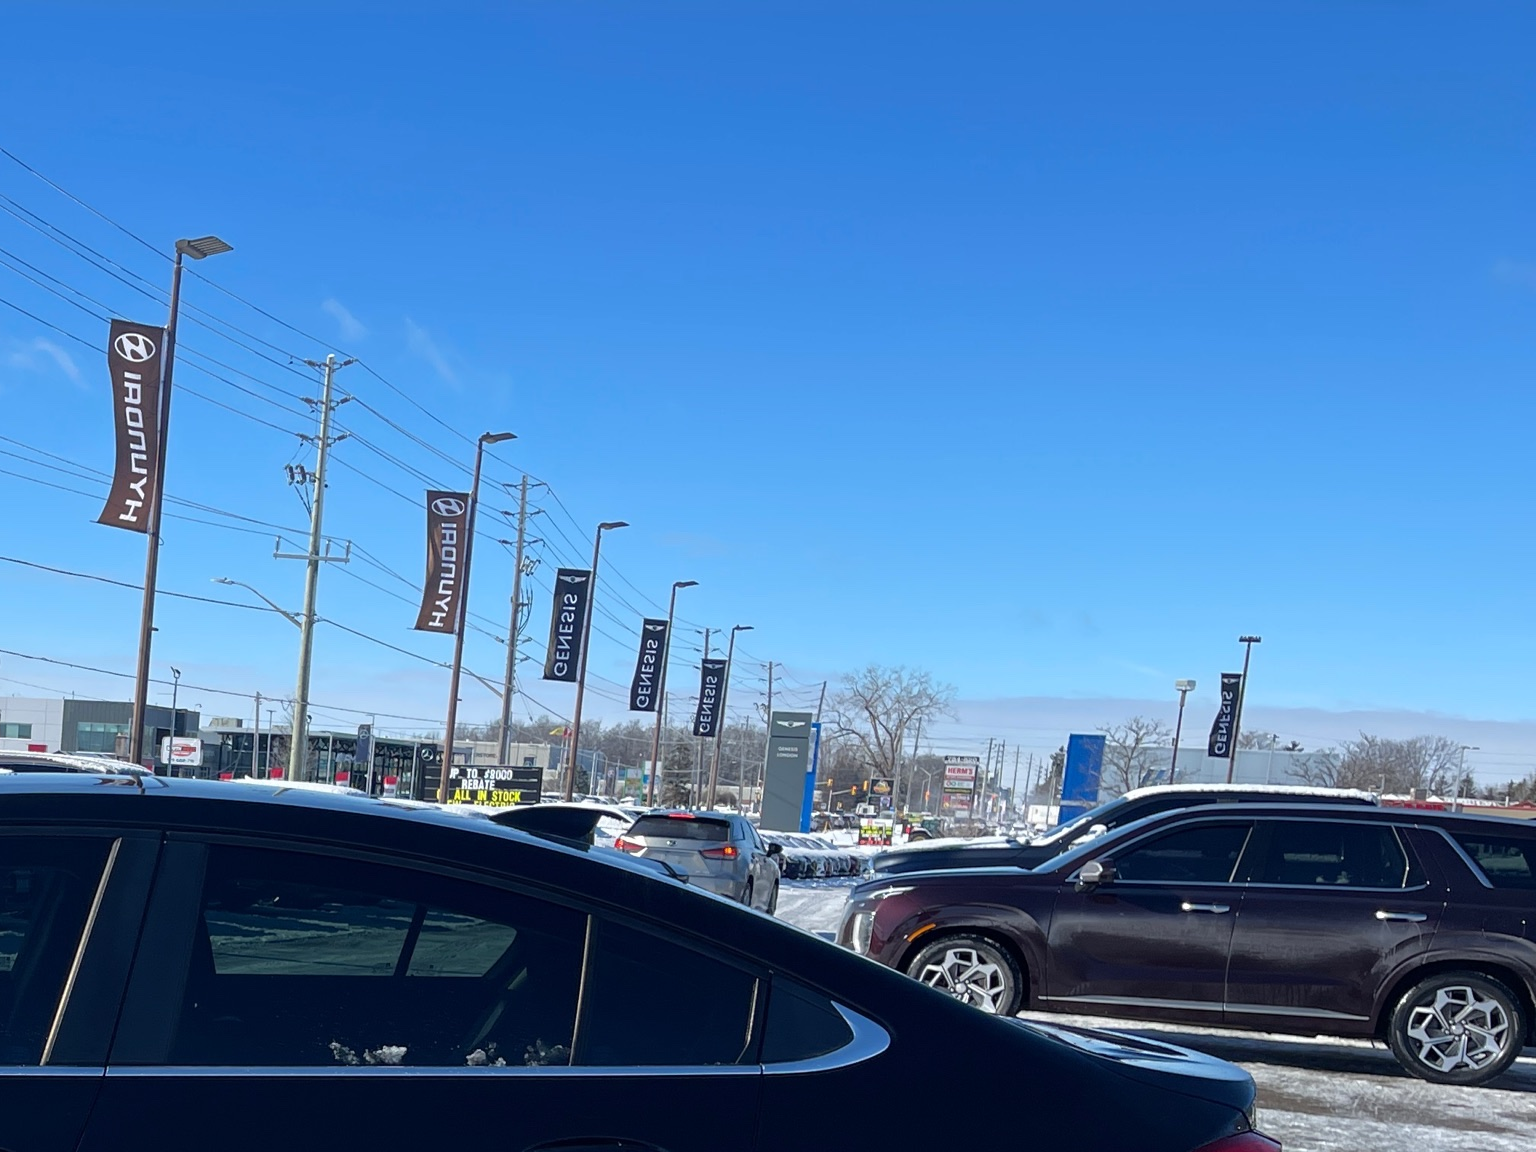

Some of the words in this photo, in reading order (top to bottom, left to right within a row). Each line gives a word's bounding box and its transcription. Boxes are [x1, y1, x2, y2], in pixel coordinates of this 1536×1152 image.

[466, 768, 478, 779] TO
[484, 768, 513, 780] $8000
[948, 767, 973, 775] HERM'S
[461, 779, 496, 790] REBATE
[453, 789, 471, 800] ALL
[477, 790, 487, 800] IN
[491, 790, 521, 802] STOCK
